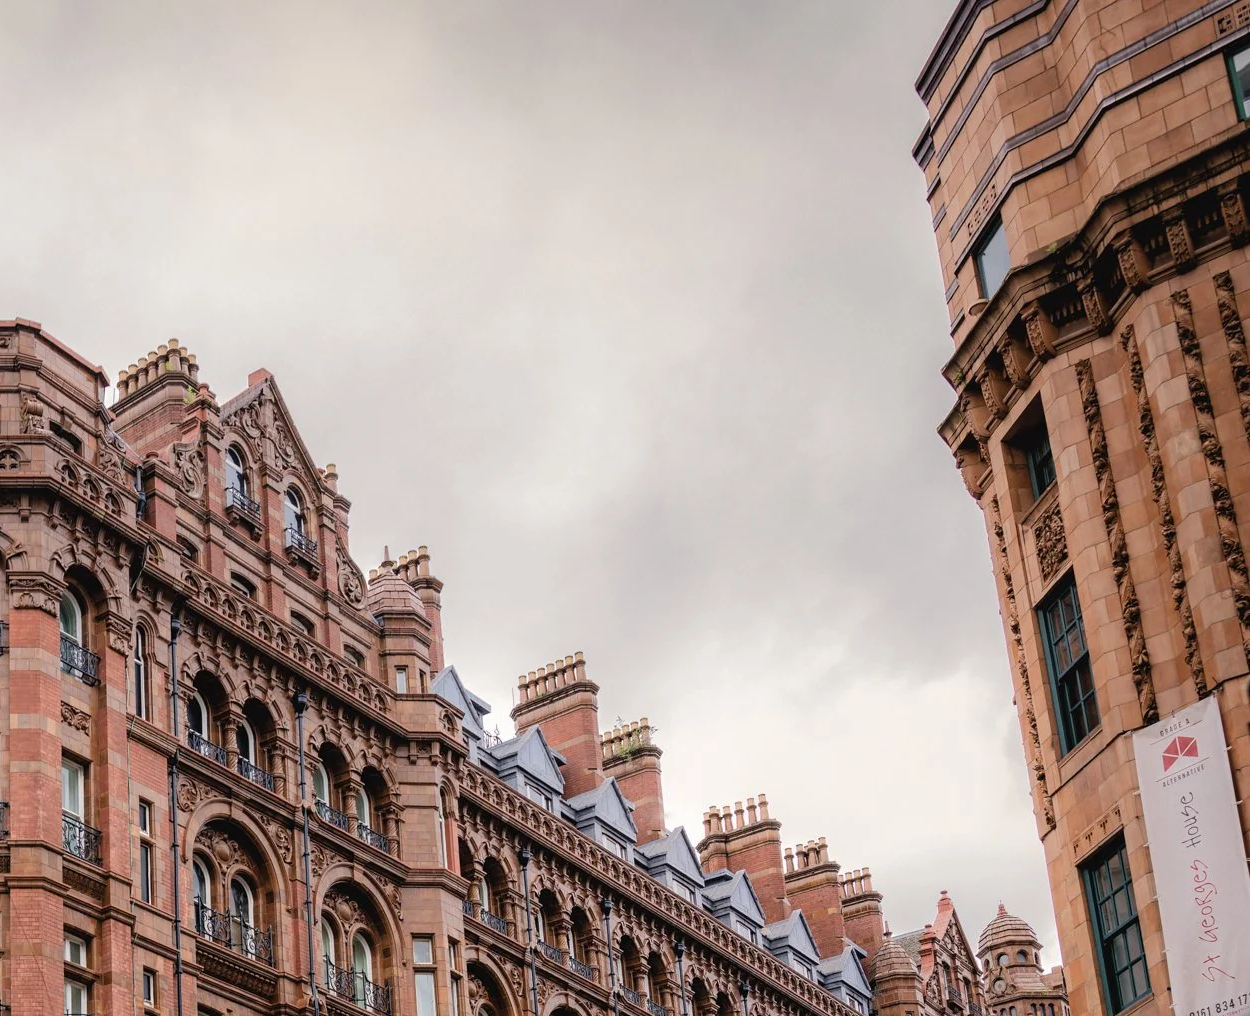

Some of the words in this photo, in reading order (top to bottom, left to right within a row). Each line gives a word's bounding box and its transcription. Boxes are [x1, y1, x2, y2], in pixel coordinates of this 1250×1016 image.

[1159, 721, 1183, 737] GRADE
[1185, 717, 1191, 725] A
[1161, 763, 1206, 788] ALTERNATIVE
[1215, 998, 1235, 1014] 834
[1237, 992, 1250, 1006] 17
